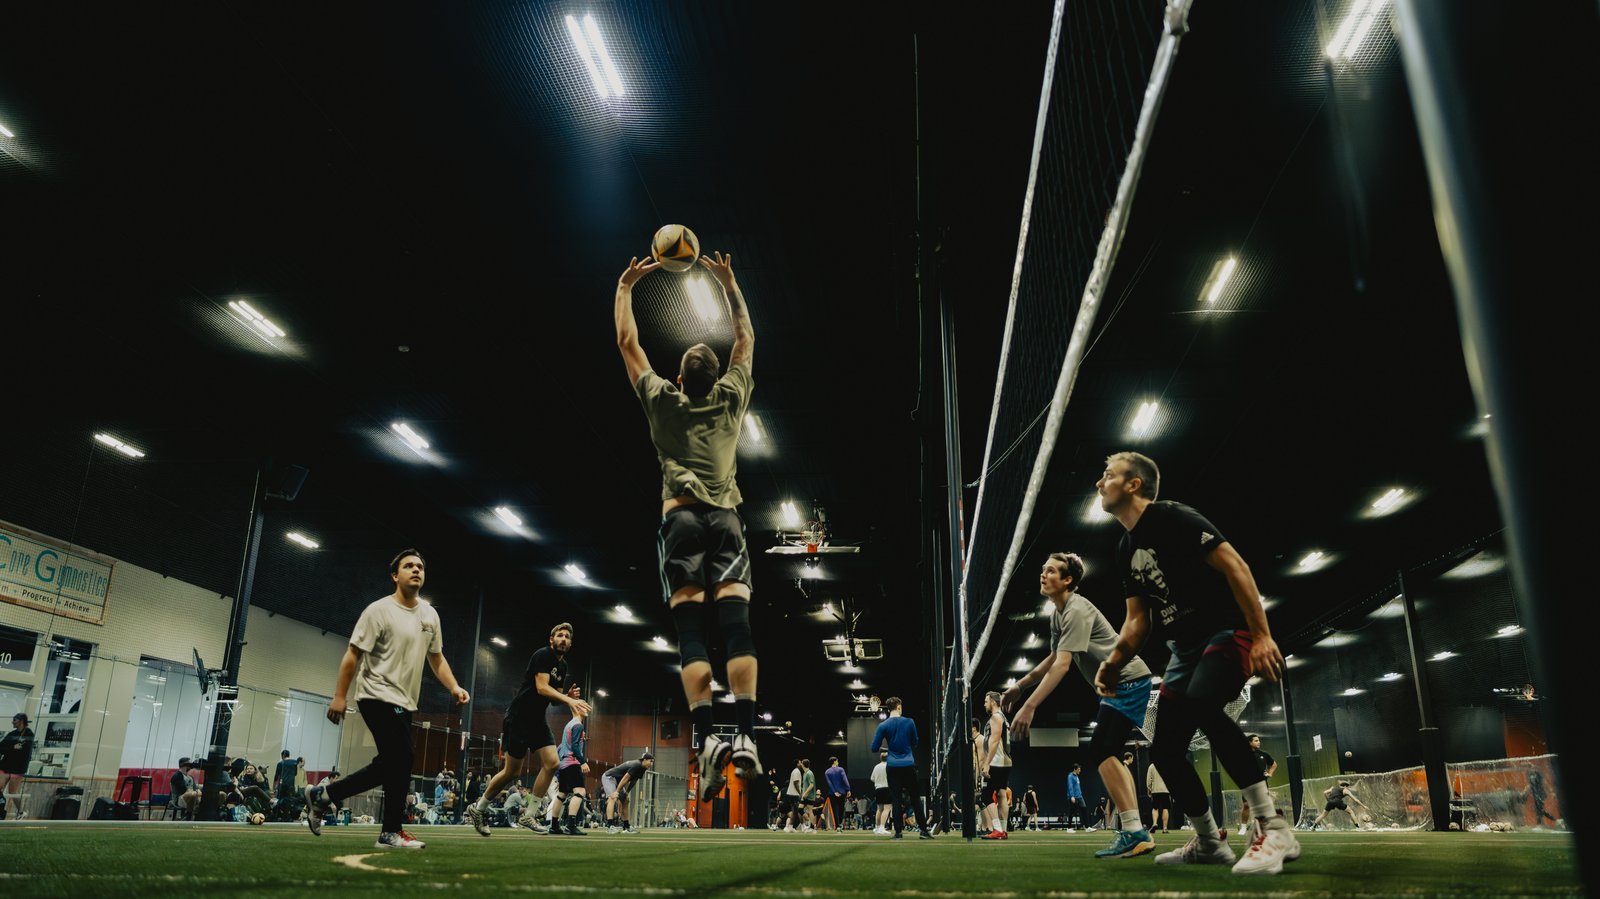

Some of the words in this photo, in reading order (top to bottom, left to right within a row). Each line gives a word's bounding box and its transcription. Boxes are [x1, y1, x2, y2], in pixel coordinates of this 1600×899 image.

[35, 549, 108, 597] Gymnastics
[22, 588, 54, 604] Progress
[64, 600, 90, 613] Achieve
